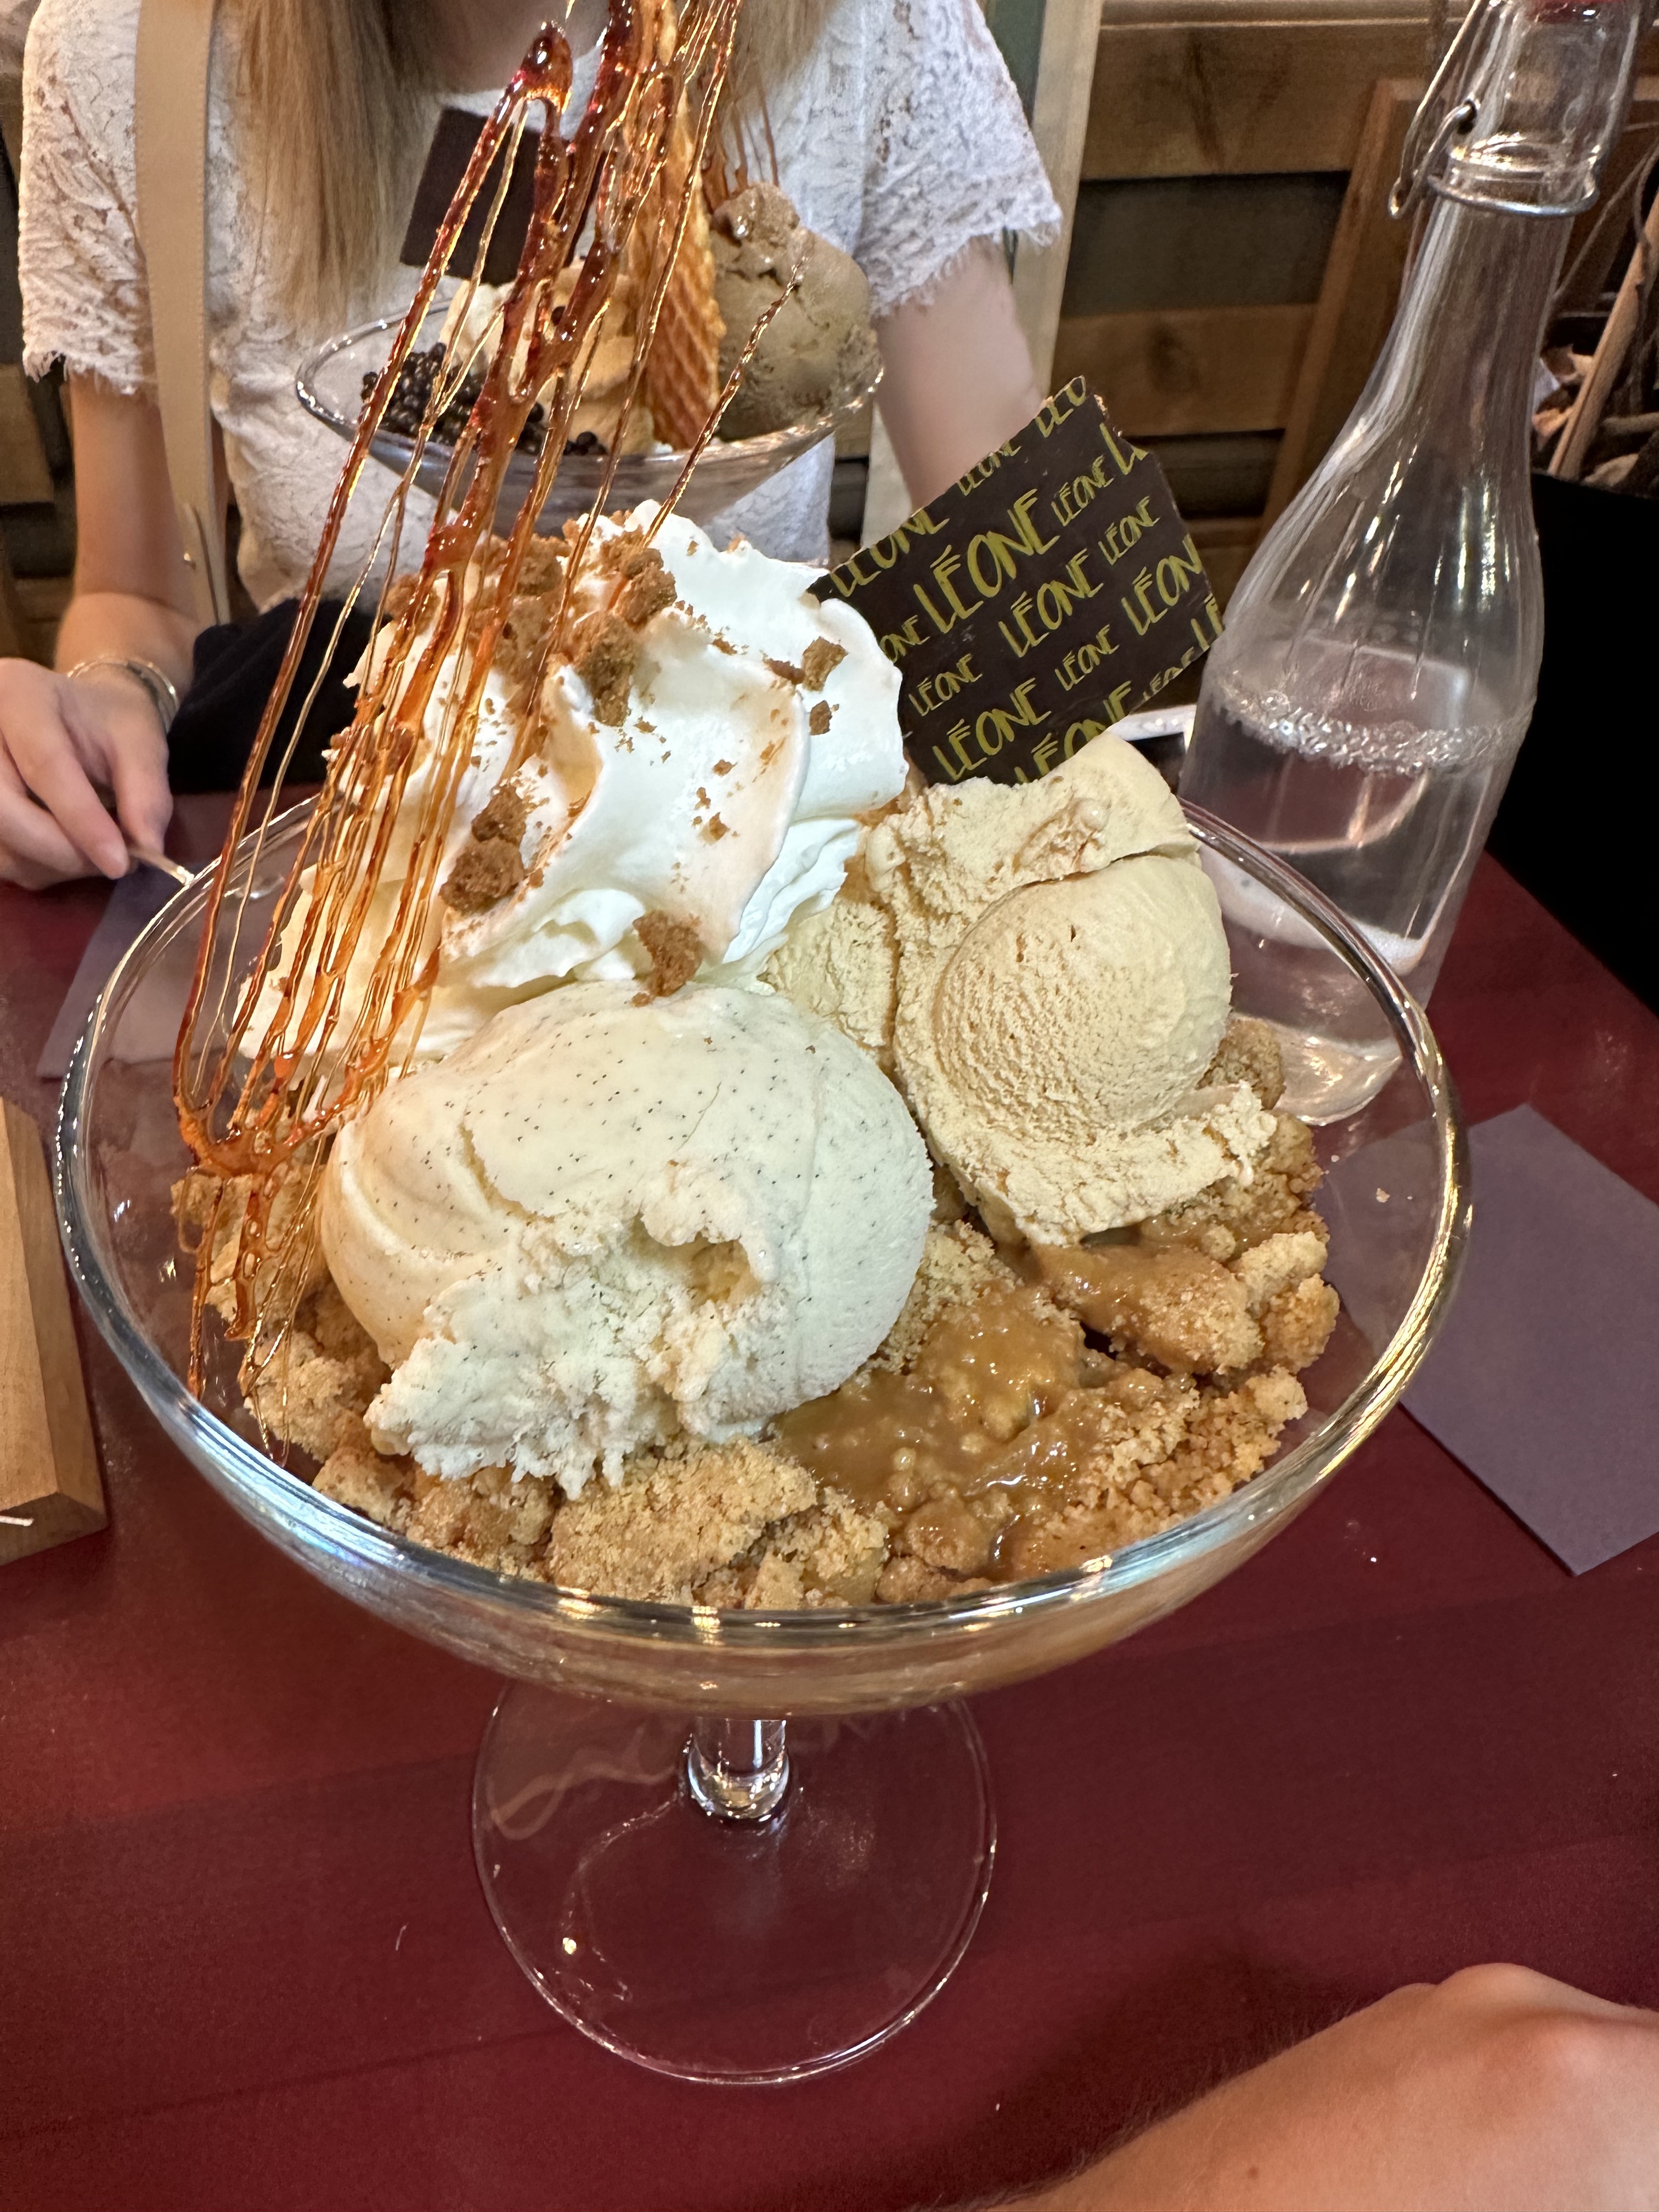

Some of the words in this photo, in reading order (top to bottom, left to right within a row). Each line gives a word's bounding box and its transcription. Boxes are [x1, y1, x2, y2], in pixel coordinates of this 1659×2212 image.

[1051, 454, 1114, 527] LÉONE
[913, 488, 1061, 634] LÉONE
[1098, 496, 1161, 566] LÉONE
[997, 548, 1104, 658] LÉONE
[908, 653, 983, 716] LÉONE
[1054, 624, 1120, 691] LÉONE
[932, 677, 1052, 781] LÉONE
